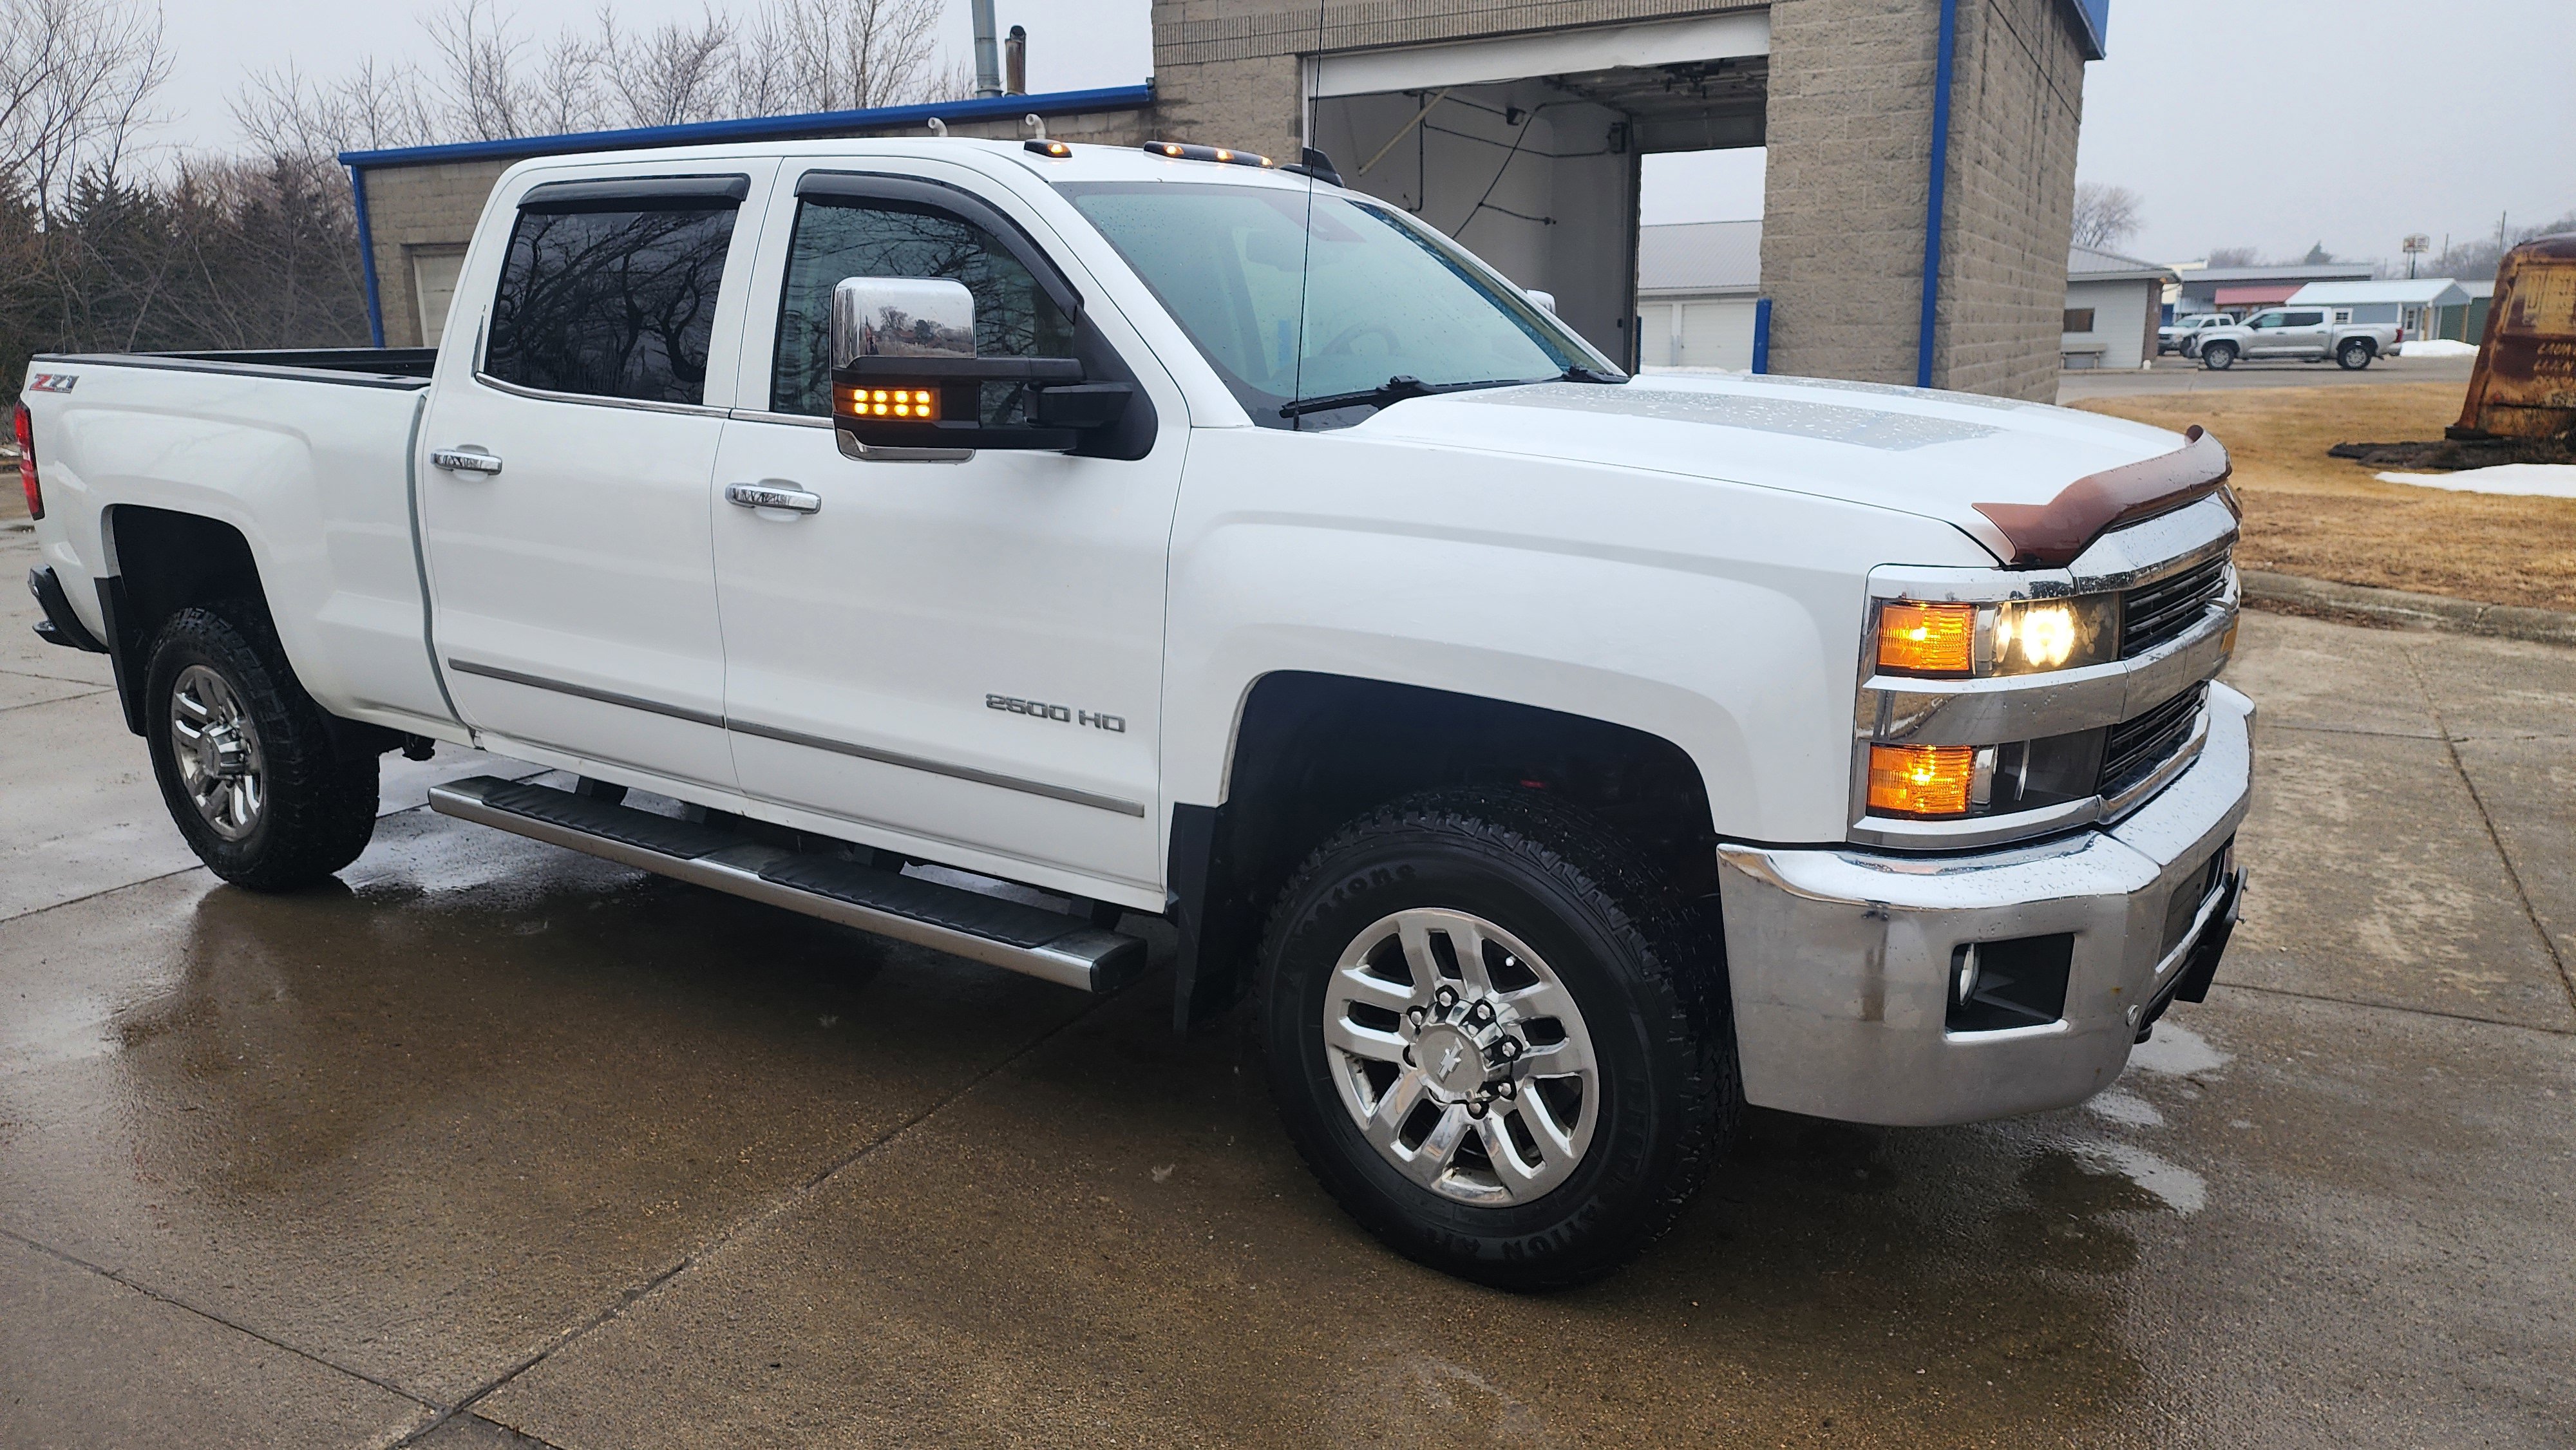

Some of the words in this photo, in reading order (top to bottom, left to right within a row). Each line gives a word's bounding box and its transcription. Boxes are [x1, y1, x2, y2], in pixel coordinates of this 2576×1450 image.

[29, 373, 79, 393] Z71
[985, 693, 1071, 722] 2500
[1079, 709, 1126, 733] HD
